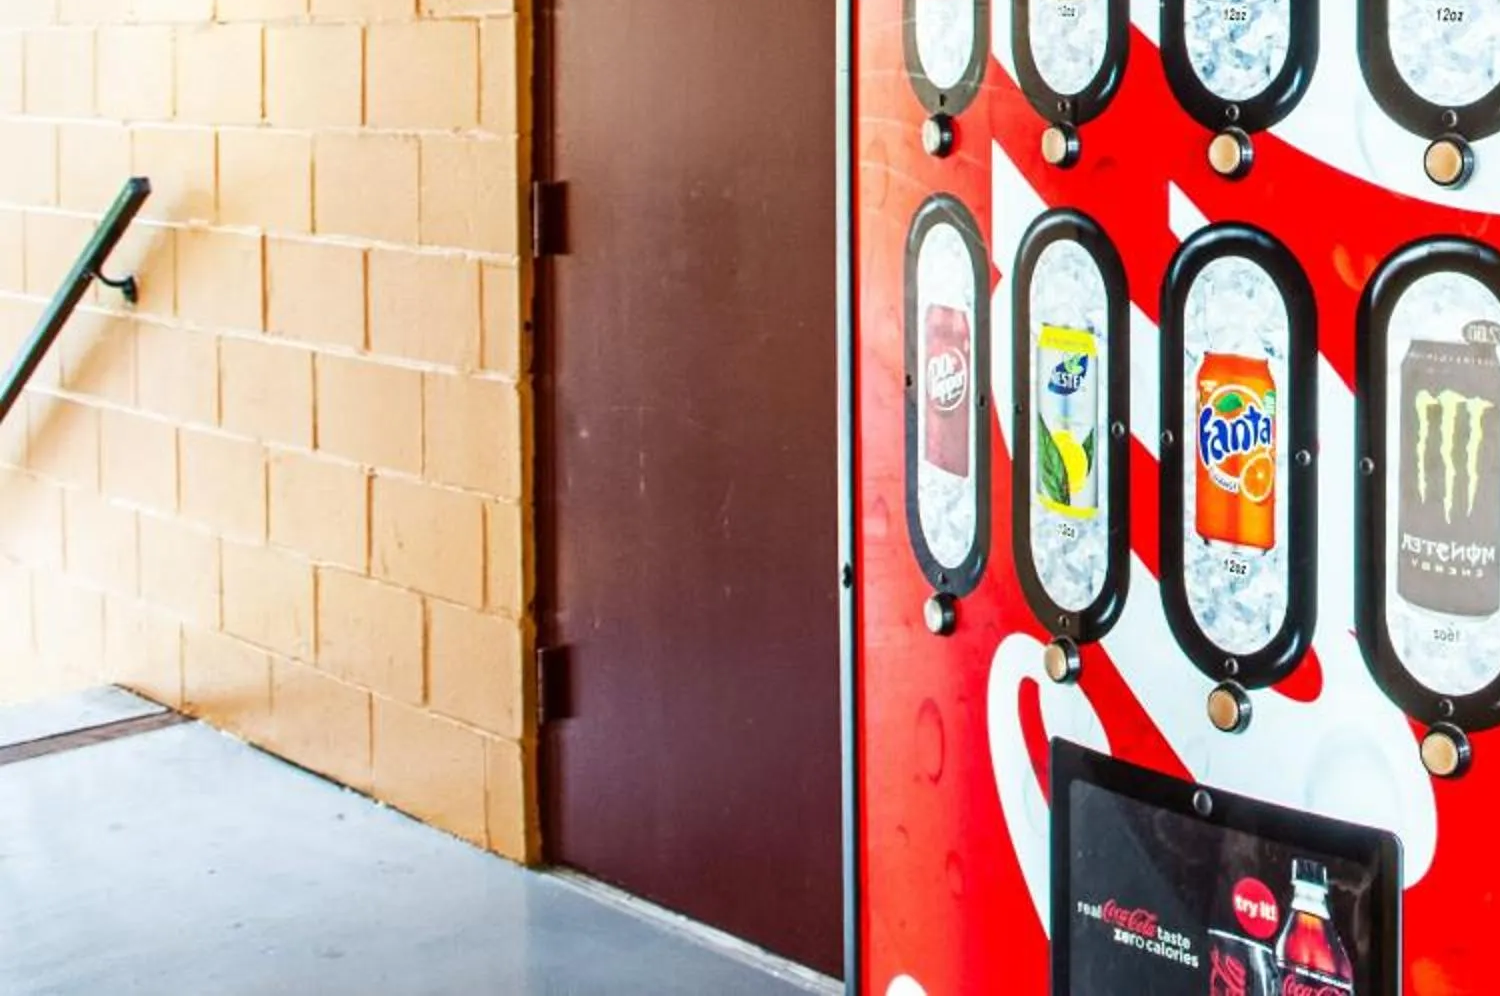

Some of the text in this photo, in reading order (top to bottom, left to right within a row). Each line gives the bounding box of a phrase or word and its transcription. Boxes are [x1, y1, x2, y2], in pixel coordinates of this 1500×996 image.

[1436, 7, 1464, 23] 12oz
[1077, 898, 1191, 950] real Coca-Cola taste
[1234, 895, 1278, 923] try it!
[1114, 927, 1199, 968] zero calories
